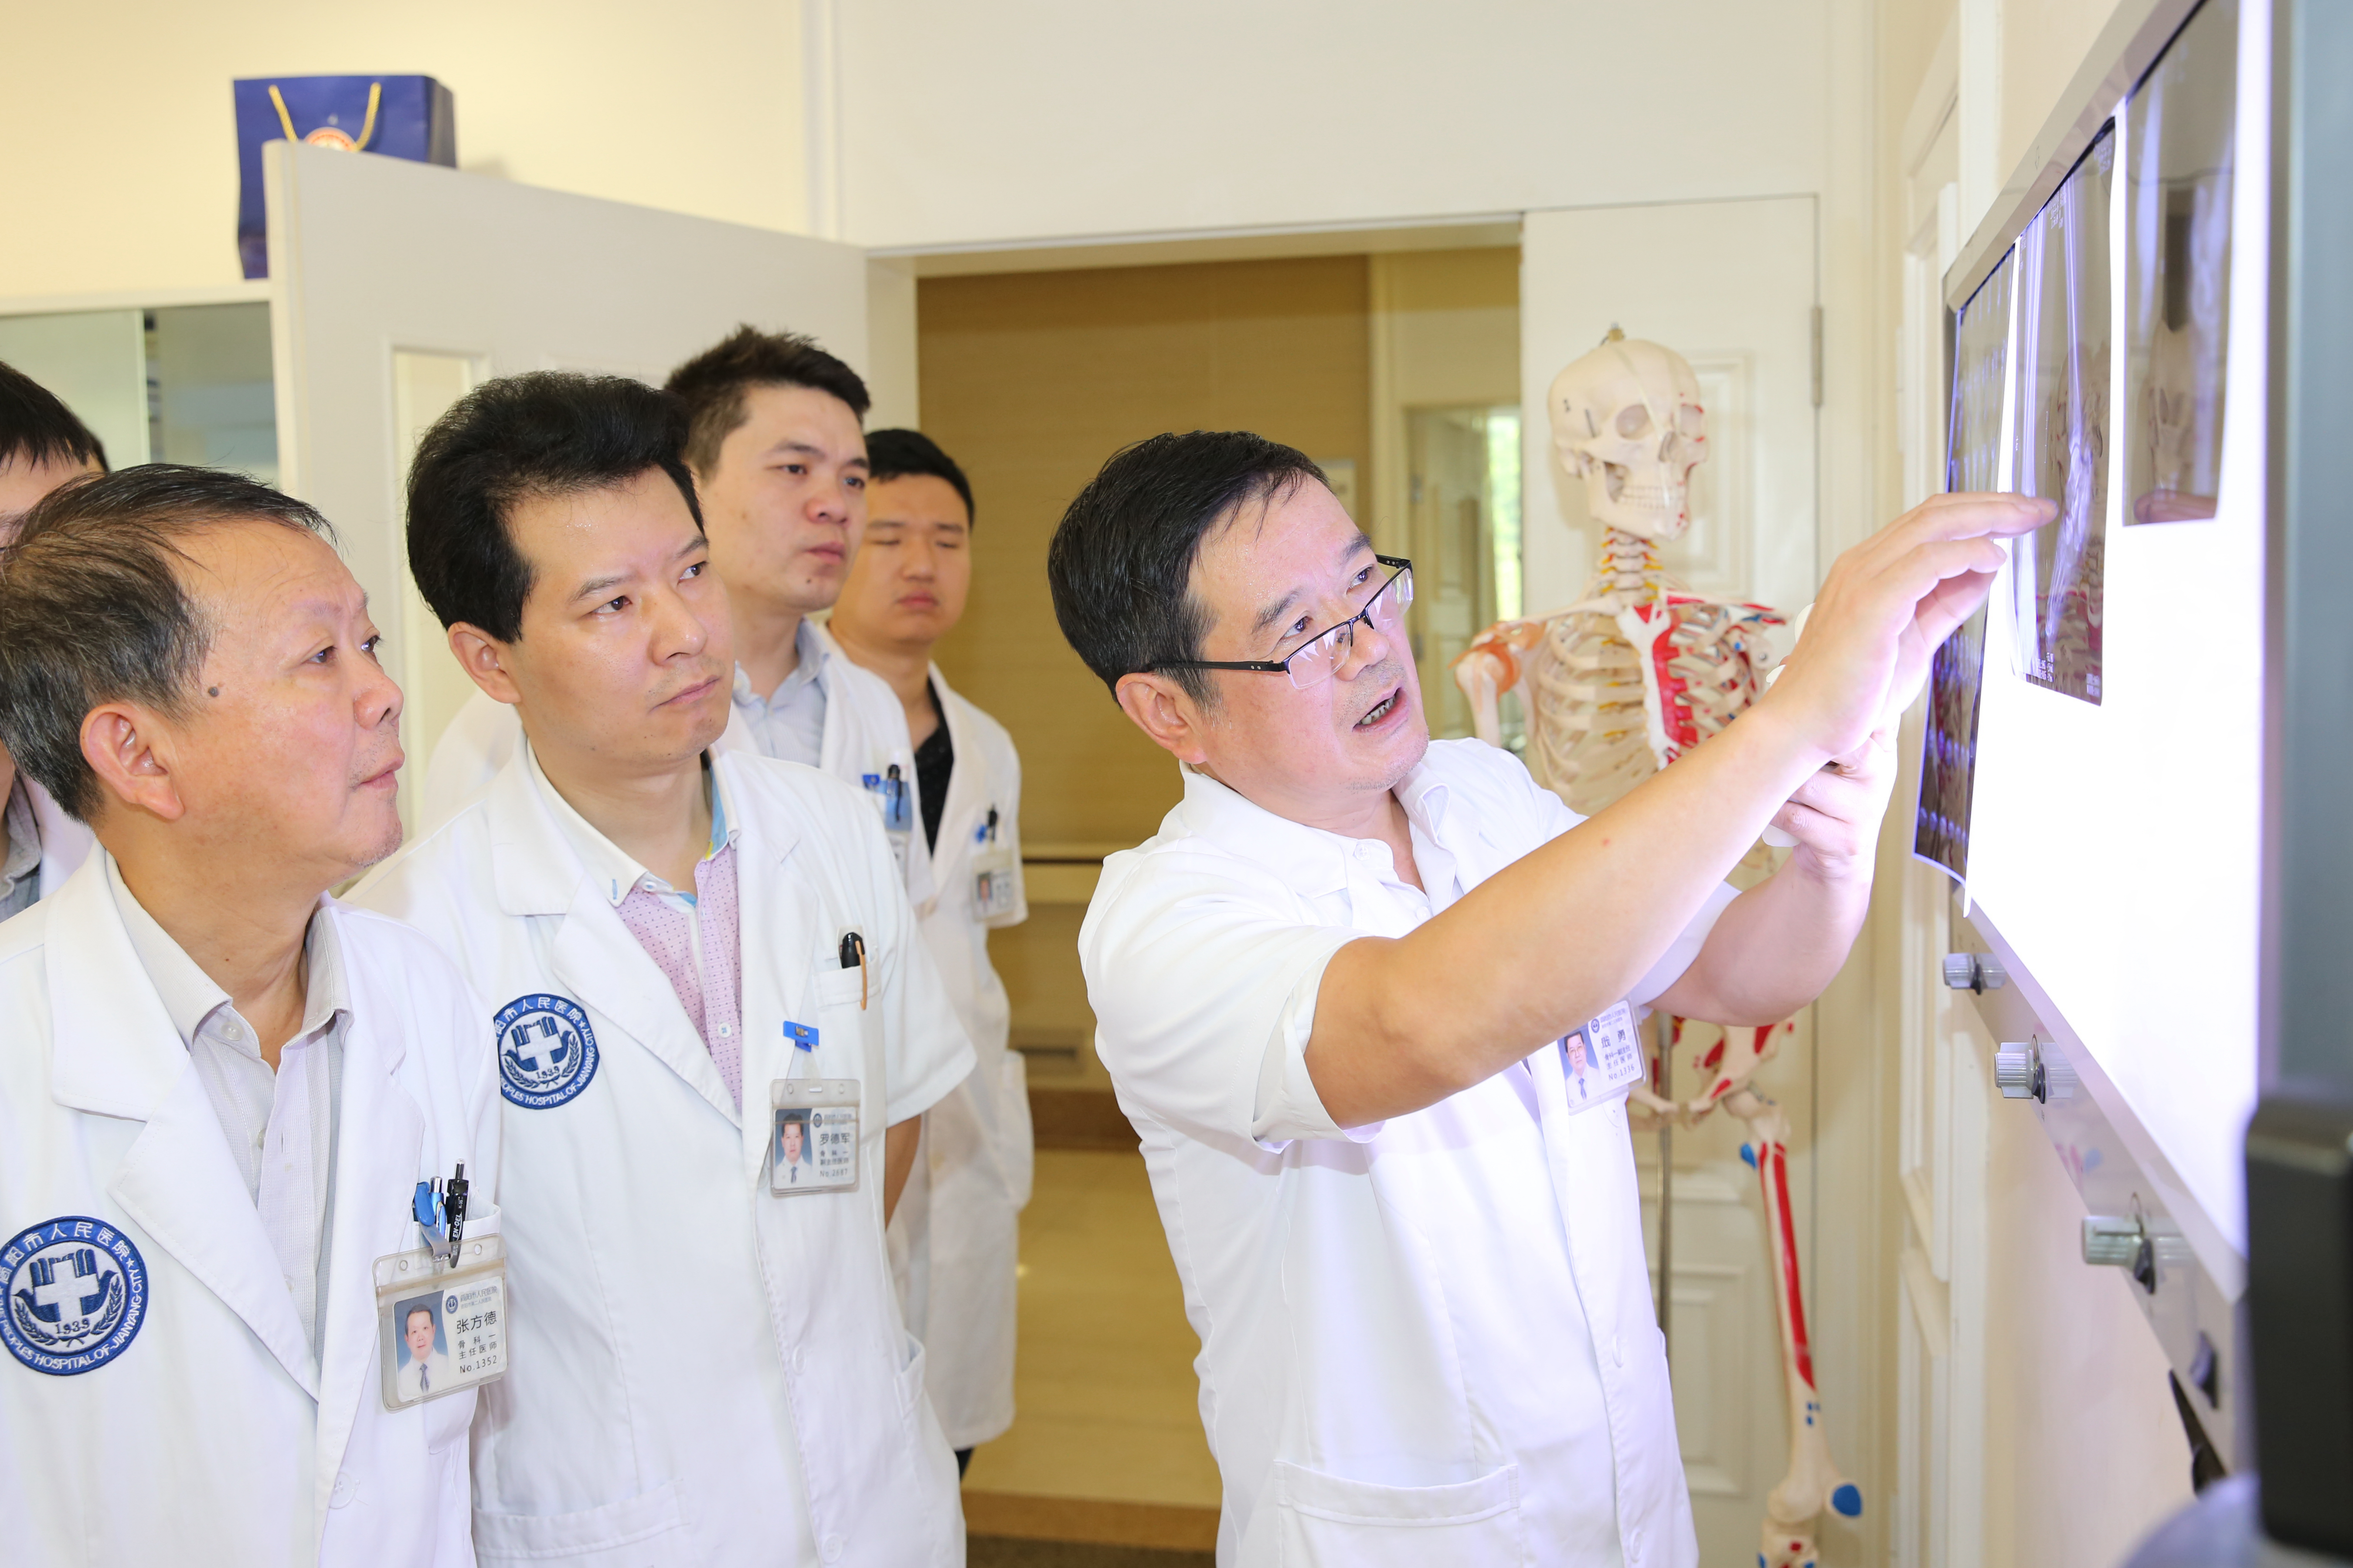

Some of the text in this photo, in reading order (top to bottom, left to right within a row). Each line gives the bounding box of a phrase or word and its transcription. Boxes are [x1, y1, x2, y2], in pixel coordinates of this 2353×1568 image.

[496, 997, 583, 1035] 阳市人民医院
[581, 1027, 594, 1047] CITY
[536, 1066, 560, 1079] 1939
[574, 1048, 595, 1088] JIANYANG
[566, 1083, 577, 1096] OF
[525, 1092, 567, 1106] HOSPITAL
[820, 1134, 850, 1146] 罗德军
[452, 1213, 462, 1238] EN-GEL
[460, 1285, 497, 1303] 简阳市人民医院
[34, 1350, 95, 1370] HOSPITAL
[94, 1344, 114, 1360] OF
[111, 1294, 142, 1350] JIANYANG
[127, 1269, 143, 1293] CITY
[54, 1317, 90, 1335] 1939
[456, 1310, 497, 1334] 张方德
[458, 1334, 496, 1350] 骨科一
[459, 1342, 497, 1360] 主任医师
[459, 1355, 497, 1374] No.1352
